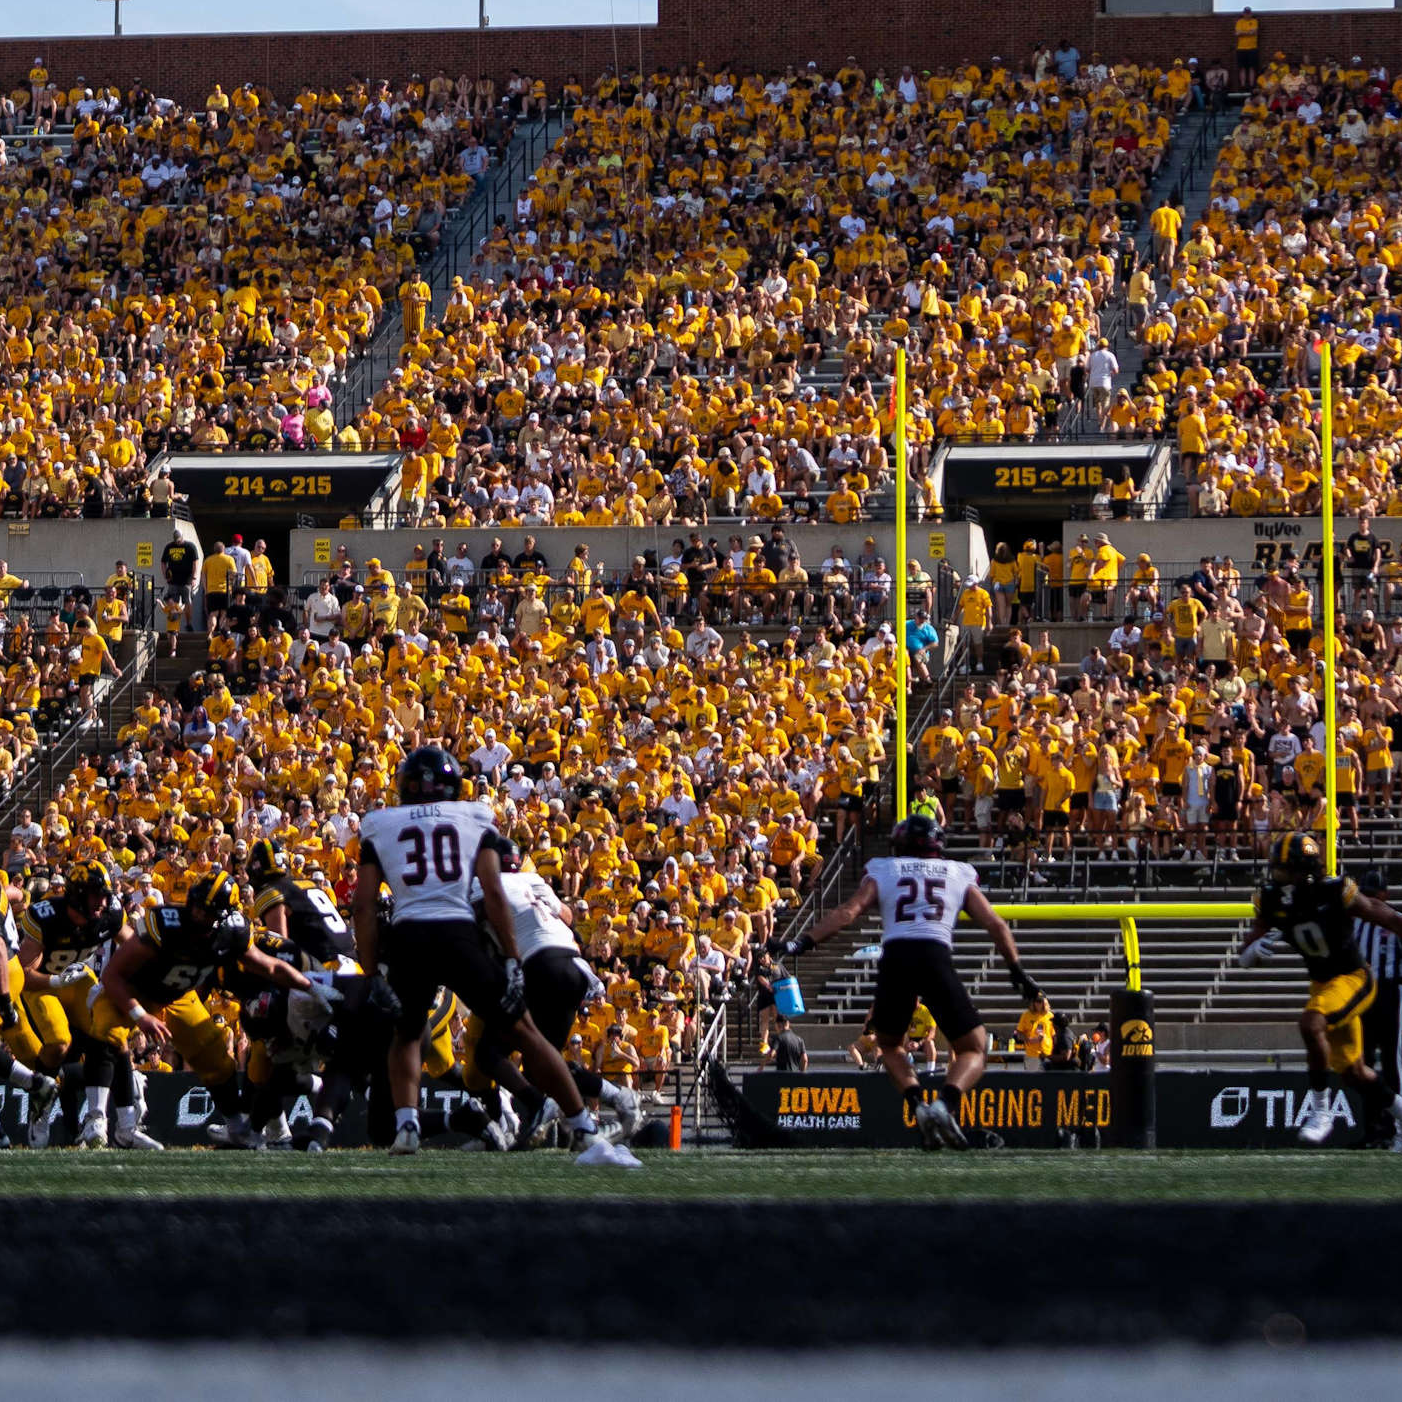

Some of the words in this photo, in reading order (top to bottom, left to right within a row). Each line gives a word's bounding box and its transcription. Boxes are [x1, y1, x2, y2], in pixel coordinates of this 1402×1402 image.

[224, 475, 265, 496] 214
[291, 475, 333, 496] 215
[995, 467, 1037, 487] 215
[1061, 466, 1103, 486] 216
[409, 805, 442, 820] ELLIS
[397, 824, 463, 886] 30
[306, 888, 347, 933] 9
[895, 877, 946, 923] 25
[1292, 921, 1330, 959] 0
[1121, 1044, 1154, 1057] IOWA
[778, 1087, 861, 1114] IOWA
[777, 1115, 826, 1129] HEALTH
[828, 1114, 862, 1129] CARE
